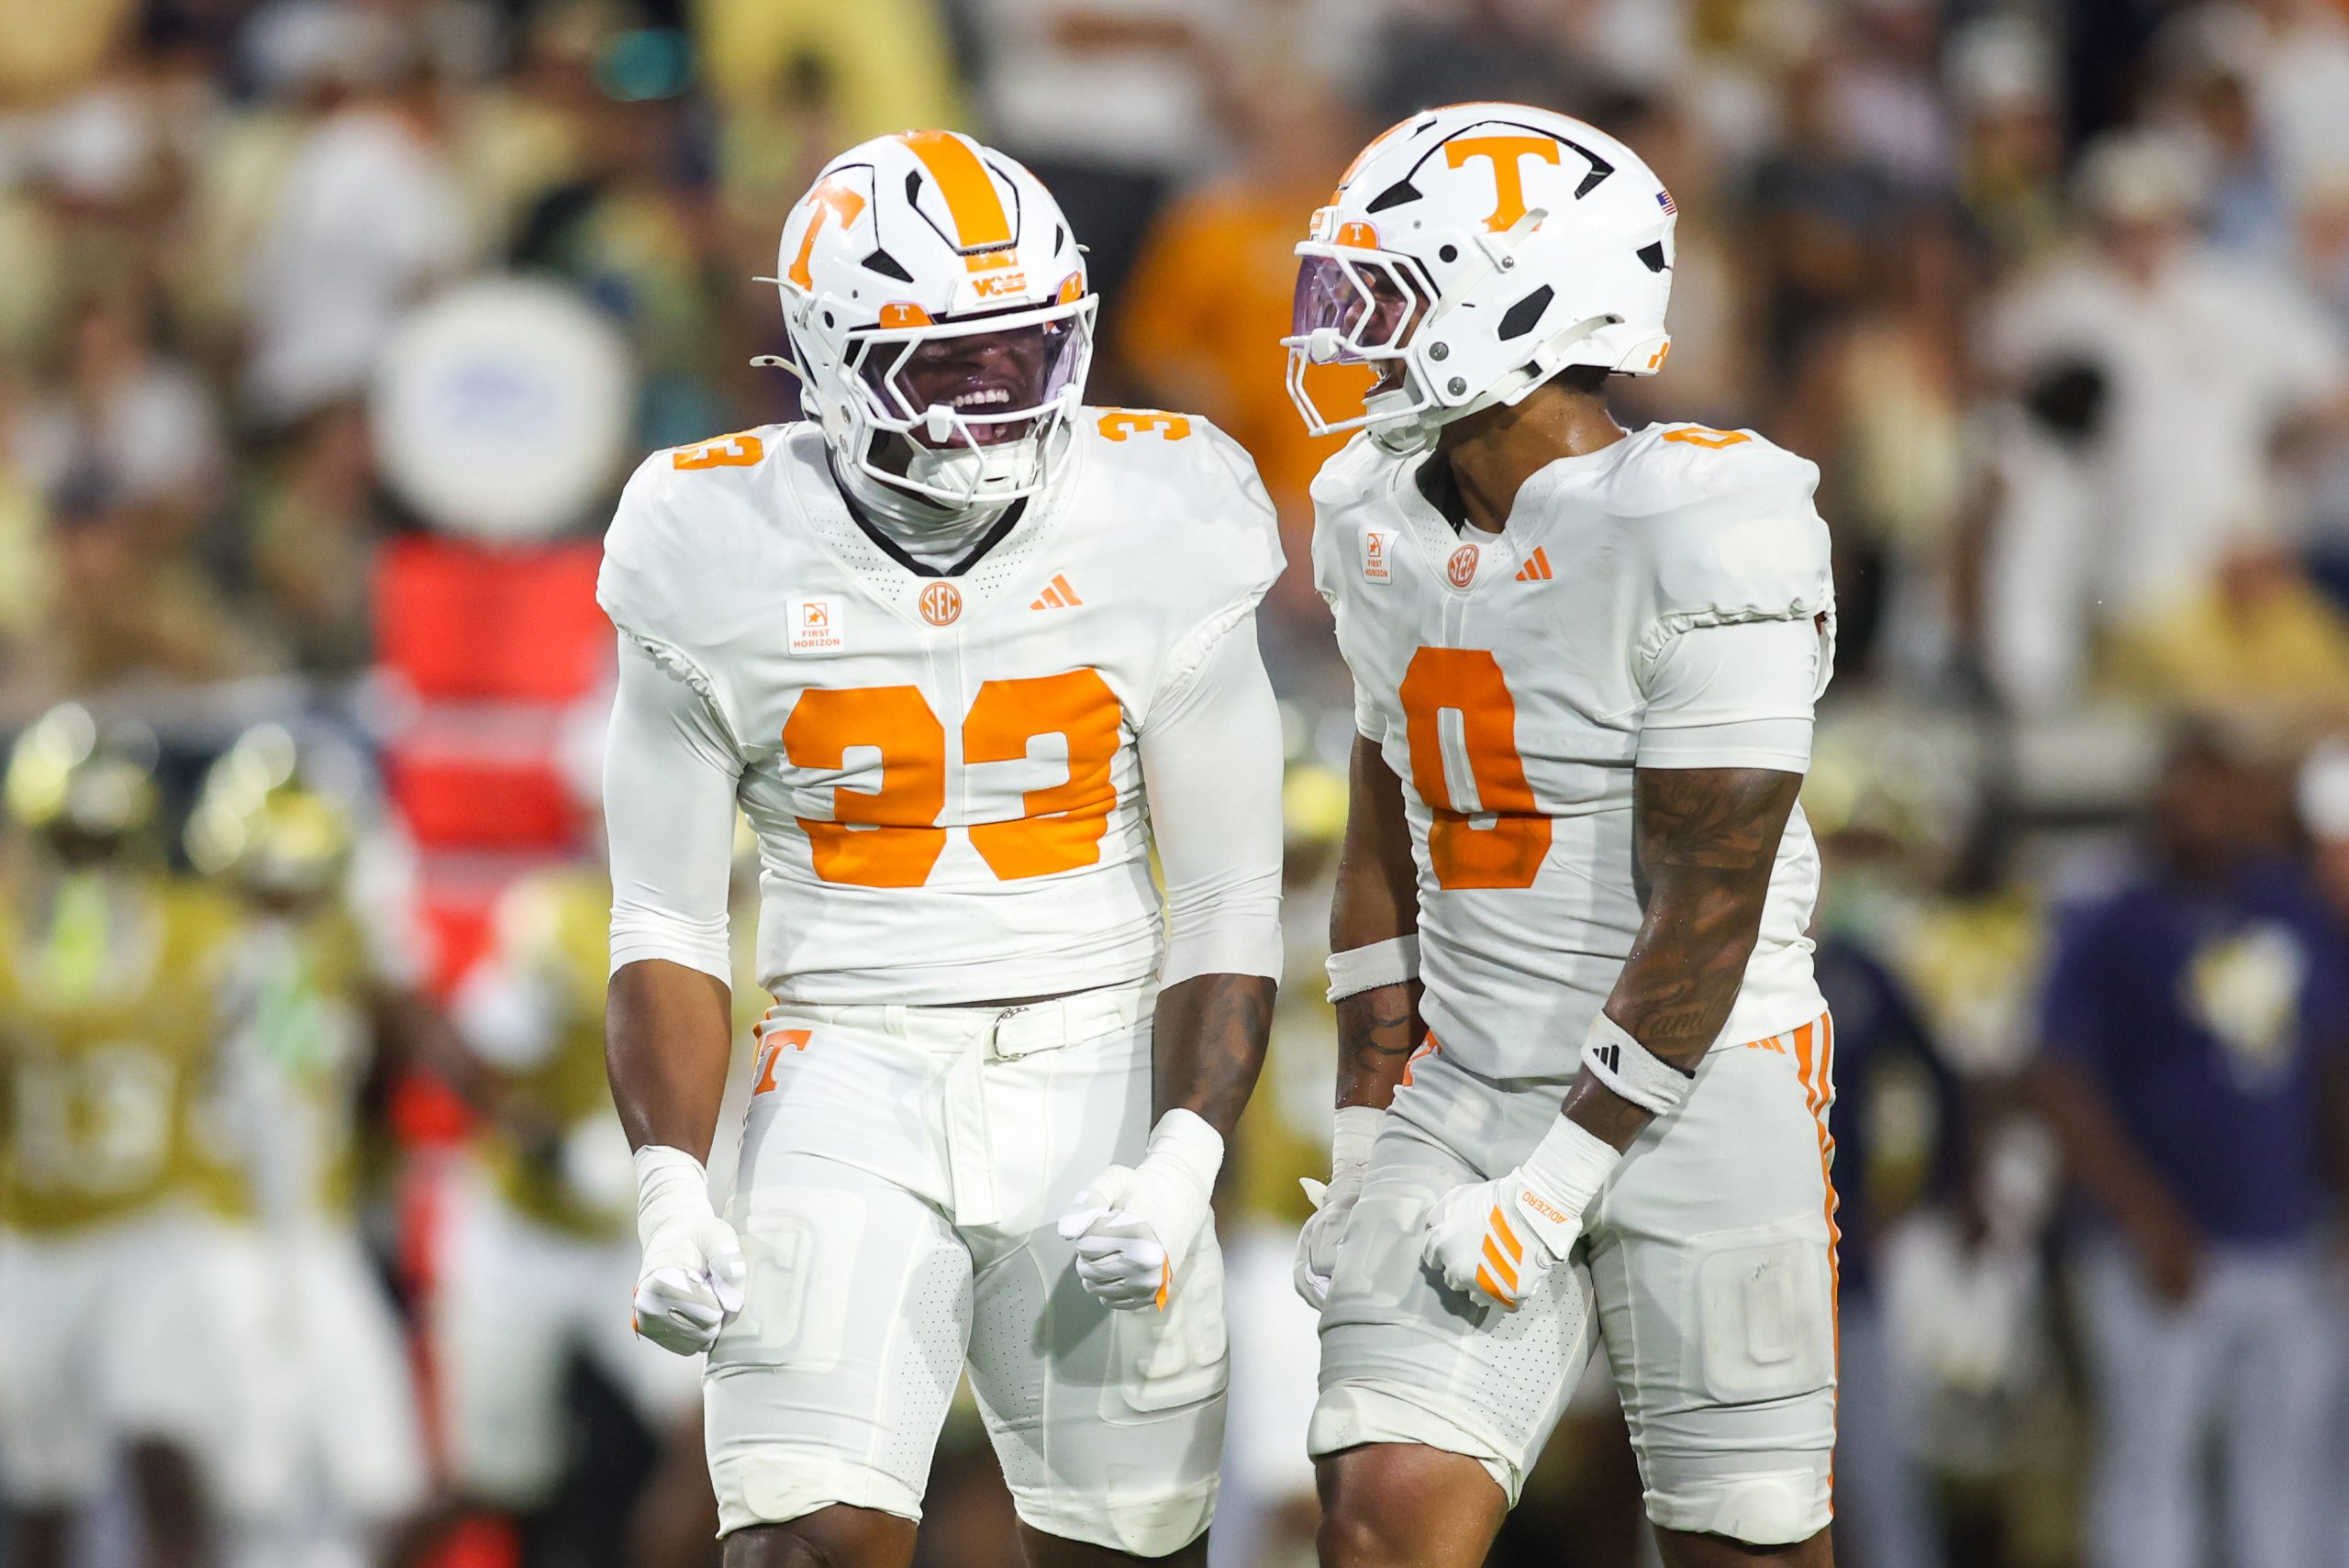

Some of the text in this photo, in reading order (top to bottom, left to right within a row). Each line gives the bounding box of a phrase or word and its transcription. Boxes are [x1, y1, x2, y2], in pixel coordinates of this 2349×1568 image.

[1443, 137, 1561, 232] T
[788, 175, 866, 292] T
[1350, 223, 1364, 240] T
[1069, 277, 1077, 294] T
[894, 305, 909, 320] T
[1364, 569, 1387, 577] HORIZON
[1367, 559, 1382, 568] FIRST
[1450, 548, 1477, 583] SEC
[923, 585, 958, 621] SEC
[794, 638, 841, 648] HORIZON
[802, 628, 829, 638] FIRST
[782, 666, 1123, 888] 33
[1398, 646, 1553, 890] 0
[753, 1029, 813, 1096] T
[1521, 1191, 1568, 1224] ADIZERO
